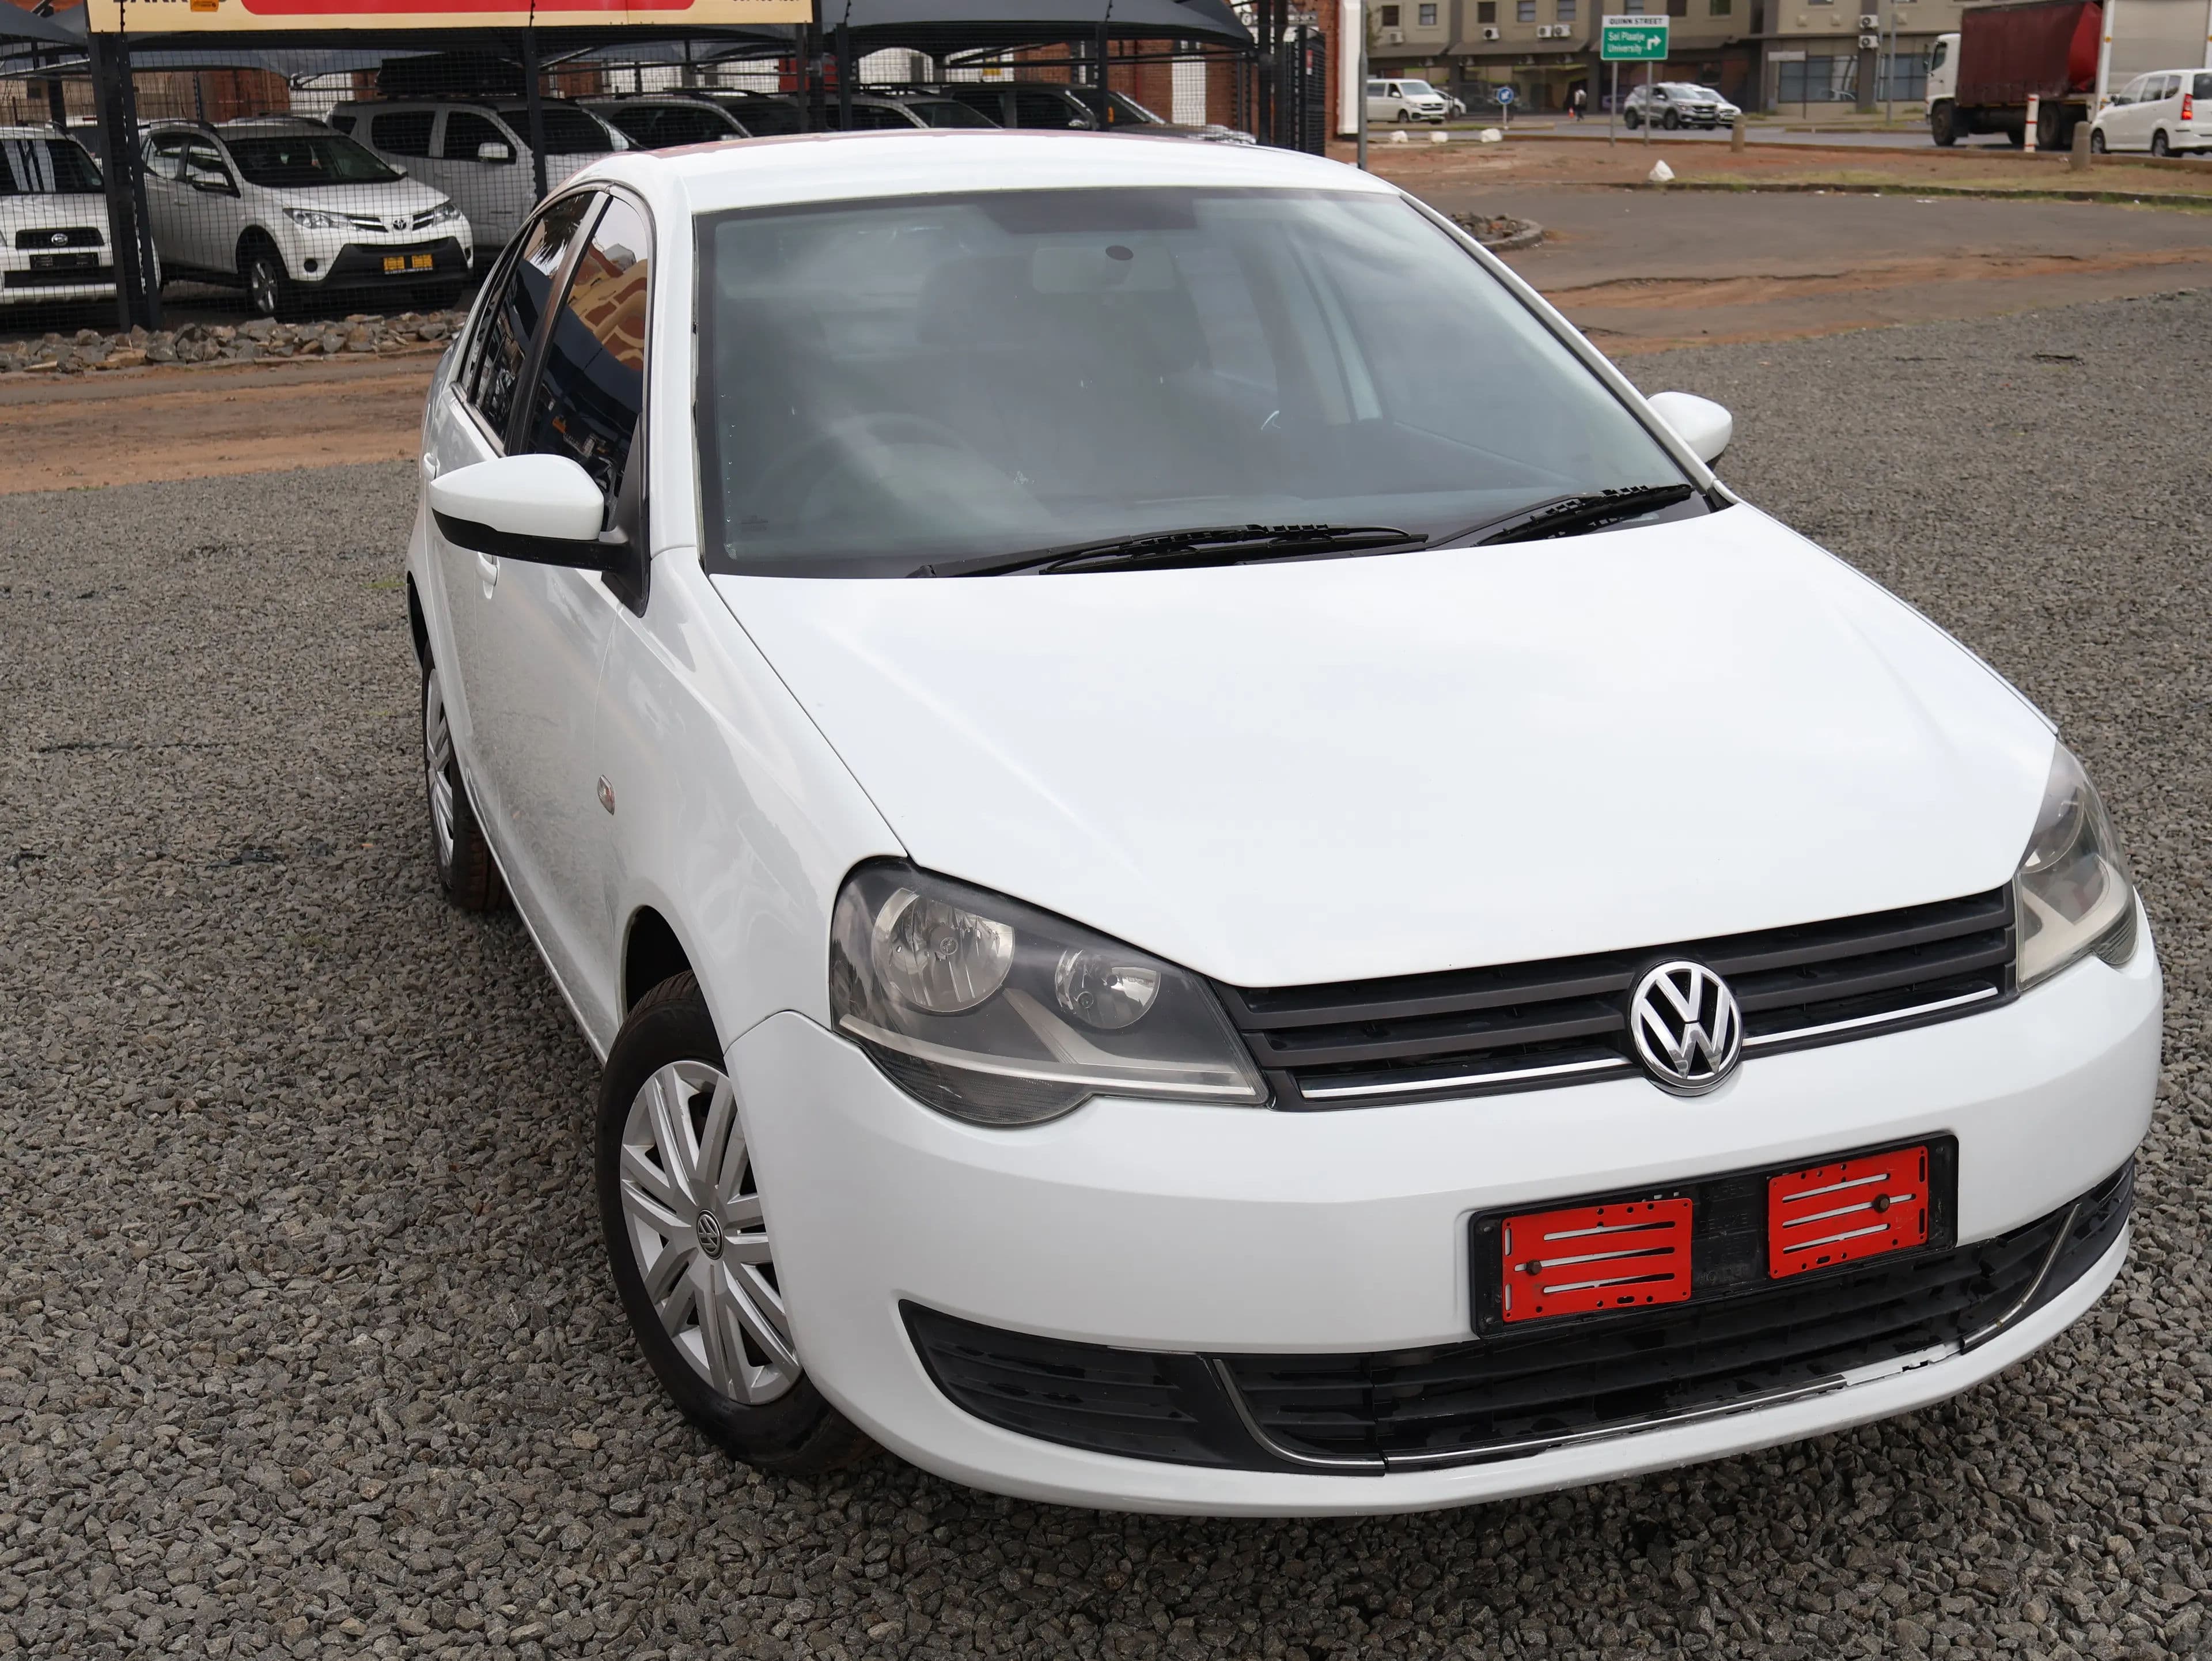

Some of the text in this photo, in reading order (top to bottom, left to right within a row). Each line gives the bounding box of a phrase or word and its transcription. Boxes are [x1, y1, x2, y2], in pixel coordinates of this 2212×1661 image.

[1608, 31, 1621, 41] Sol
[1607, 44, 1642, 55] University
[1631, 961, 1741, 1088] VW
